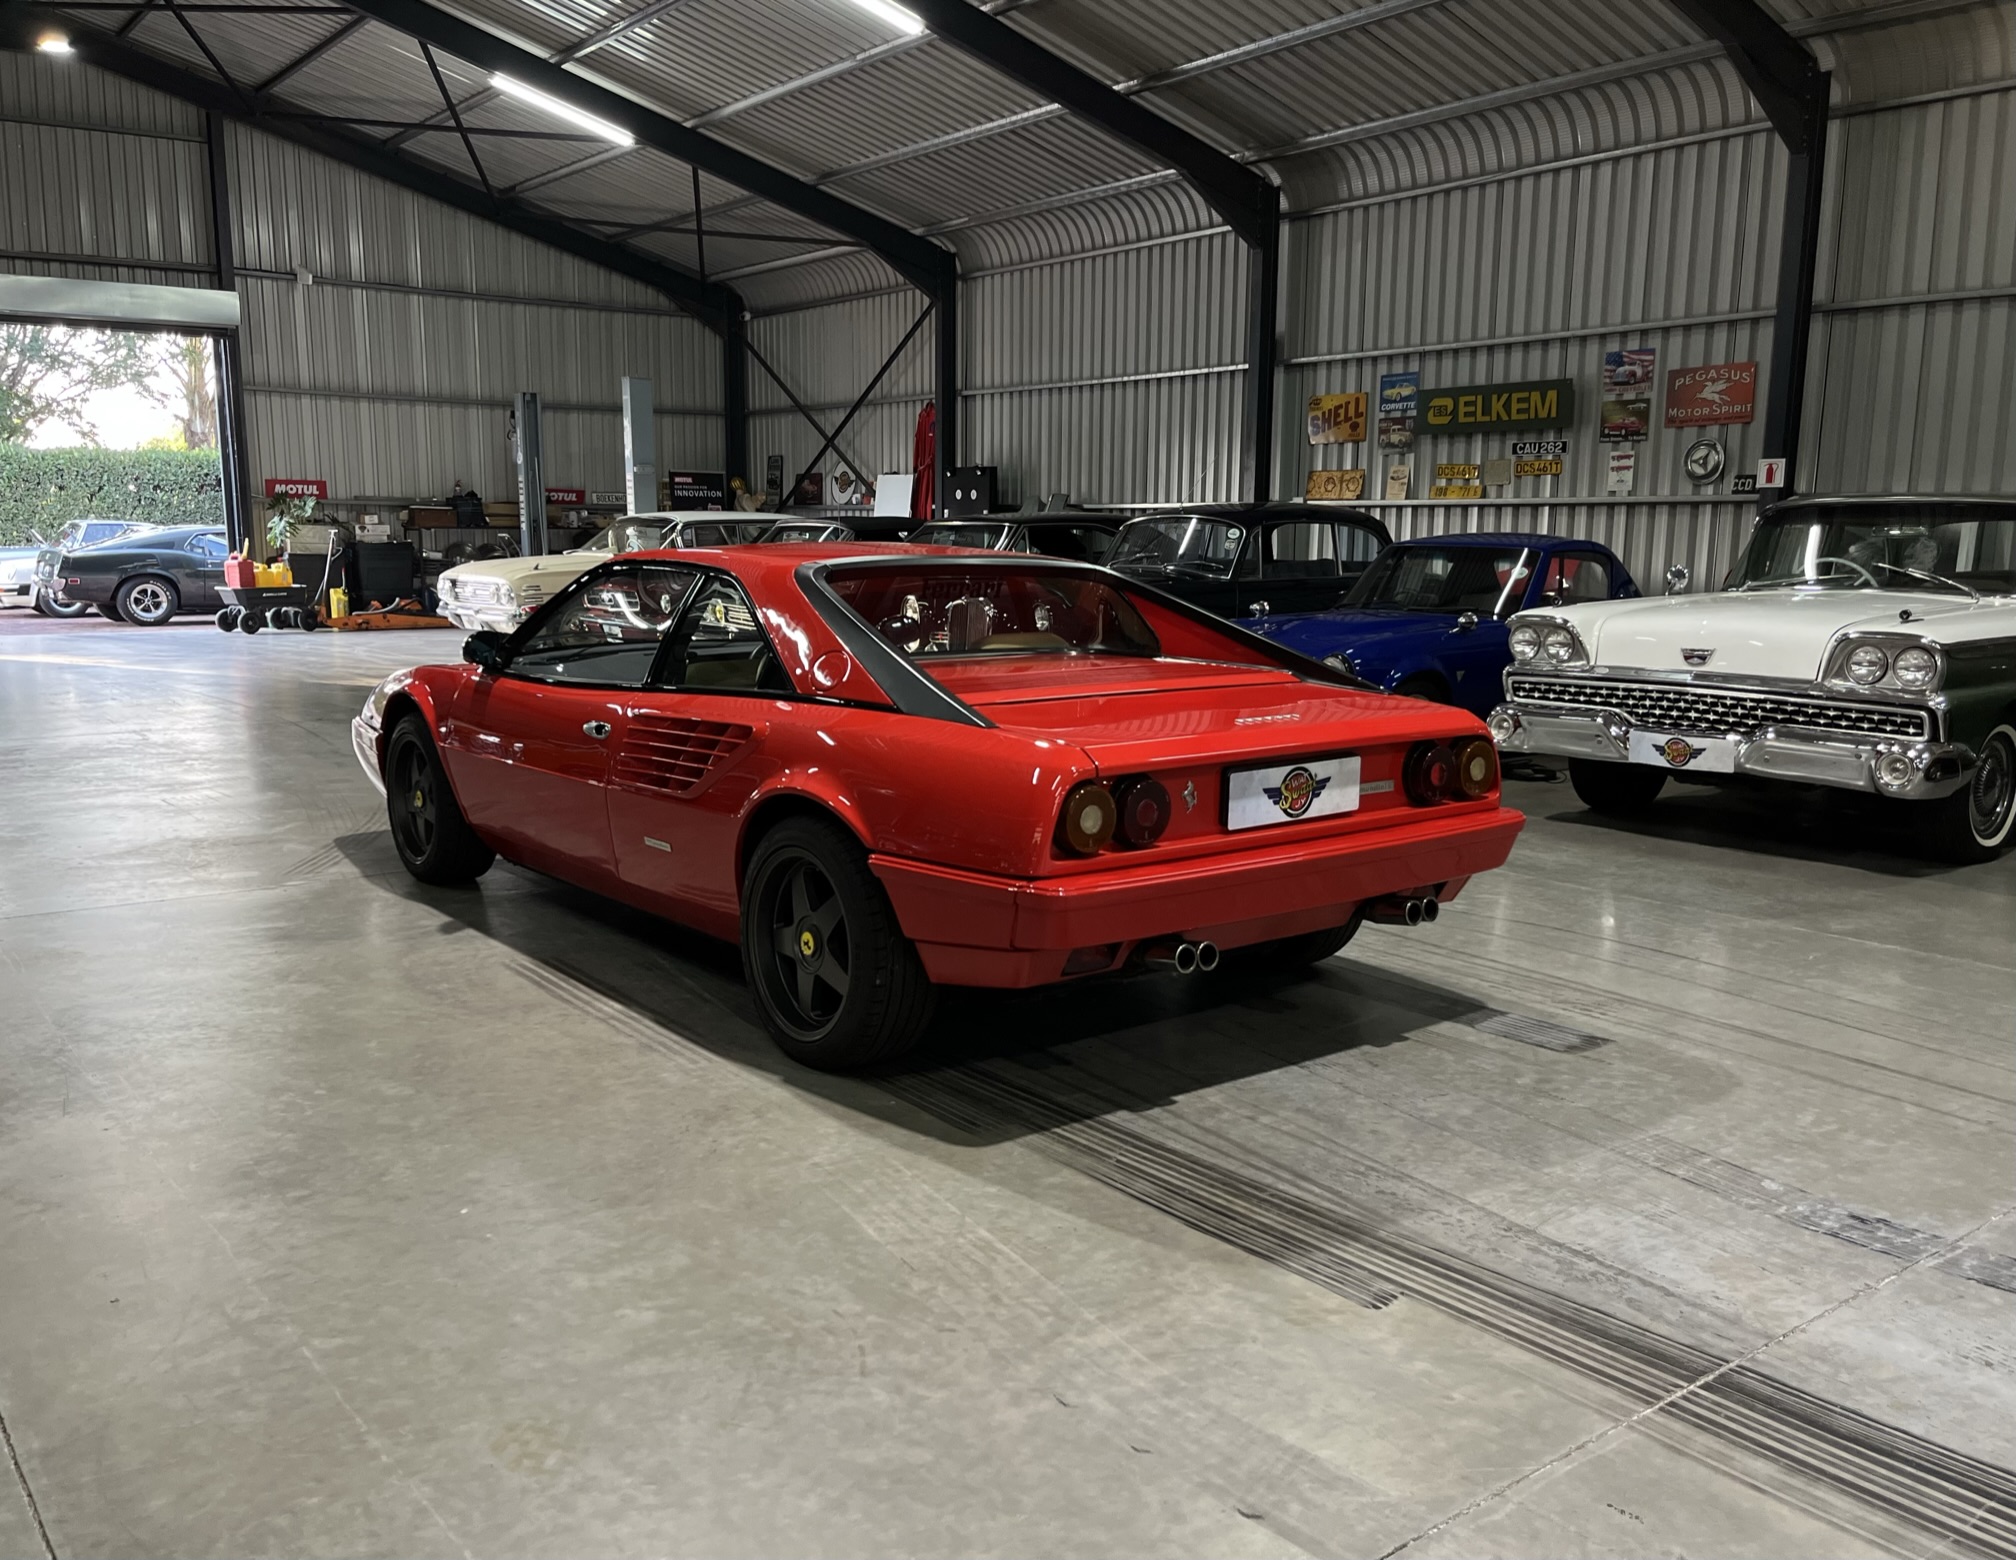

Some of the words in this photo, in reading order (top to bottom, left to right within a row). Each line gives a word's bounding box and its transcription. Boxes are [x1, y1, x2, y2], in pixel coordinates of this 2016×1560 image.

[1674, 368, 1750, 391] PEGASUS
[1381, 401, 1416, 411] CORVETTE
[1458, 389, 1558, 424] ELKEM
[1668, 407, 1710, 418] MOTOR
[1712, 403, 1752, 415] SPIRIT
[1309, 396, 1364, 437] SHELL
[1516, 443, 1539, 454] CAU
[1540, 442, 1562, 453] 262
[1515, 461, 1560, 474] DCS461T
[274, 483, 320, 495] MOTUL
[674, 489, 722, 498] INNOVATION
[546, 492, 578, 501] OTUL
